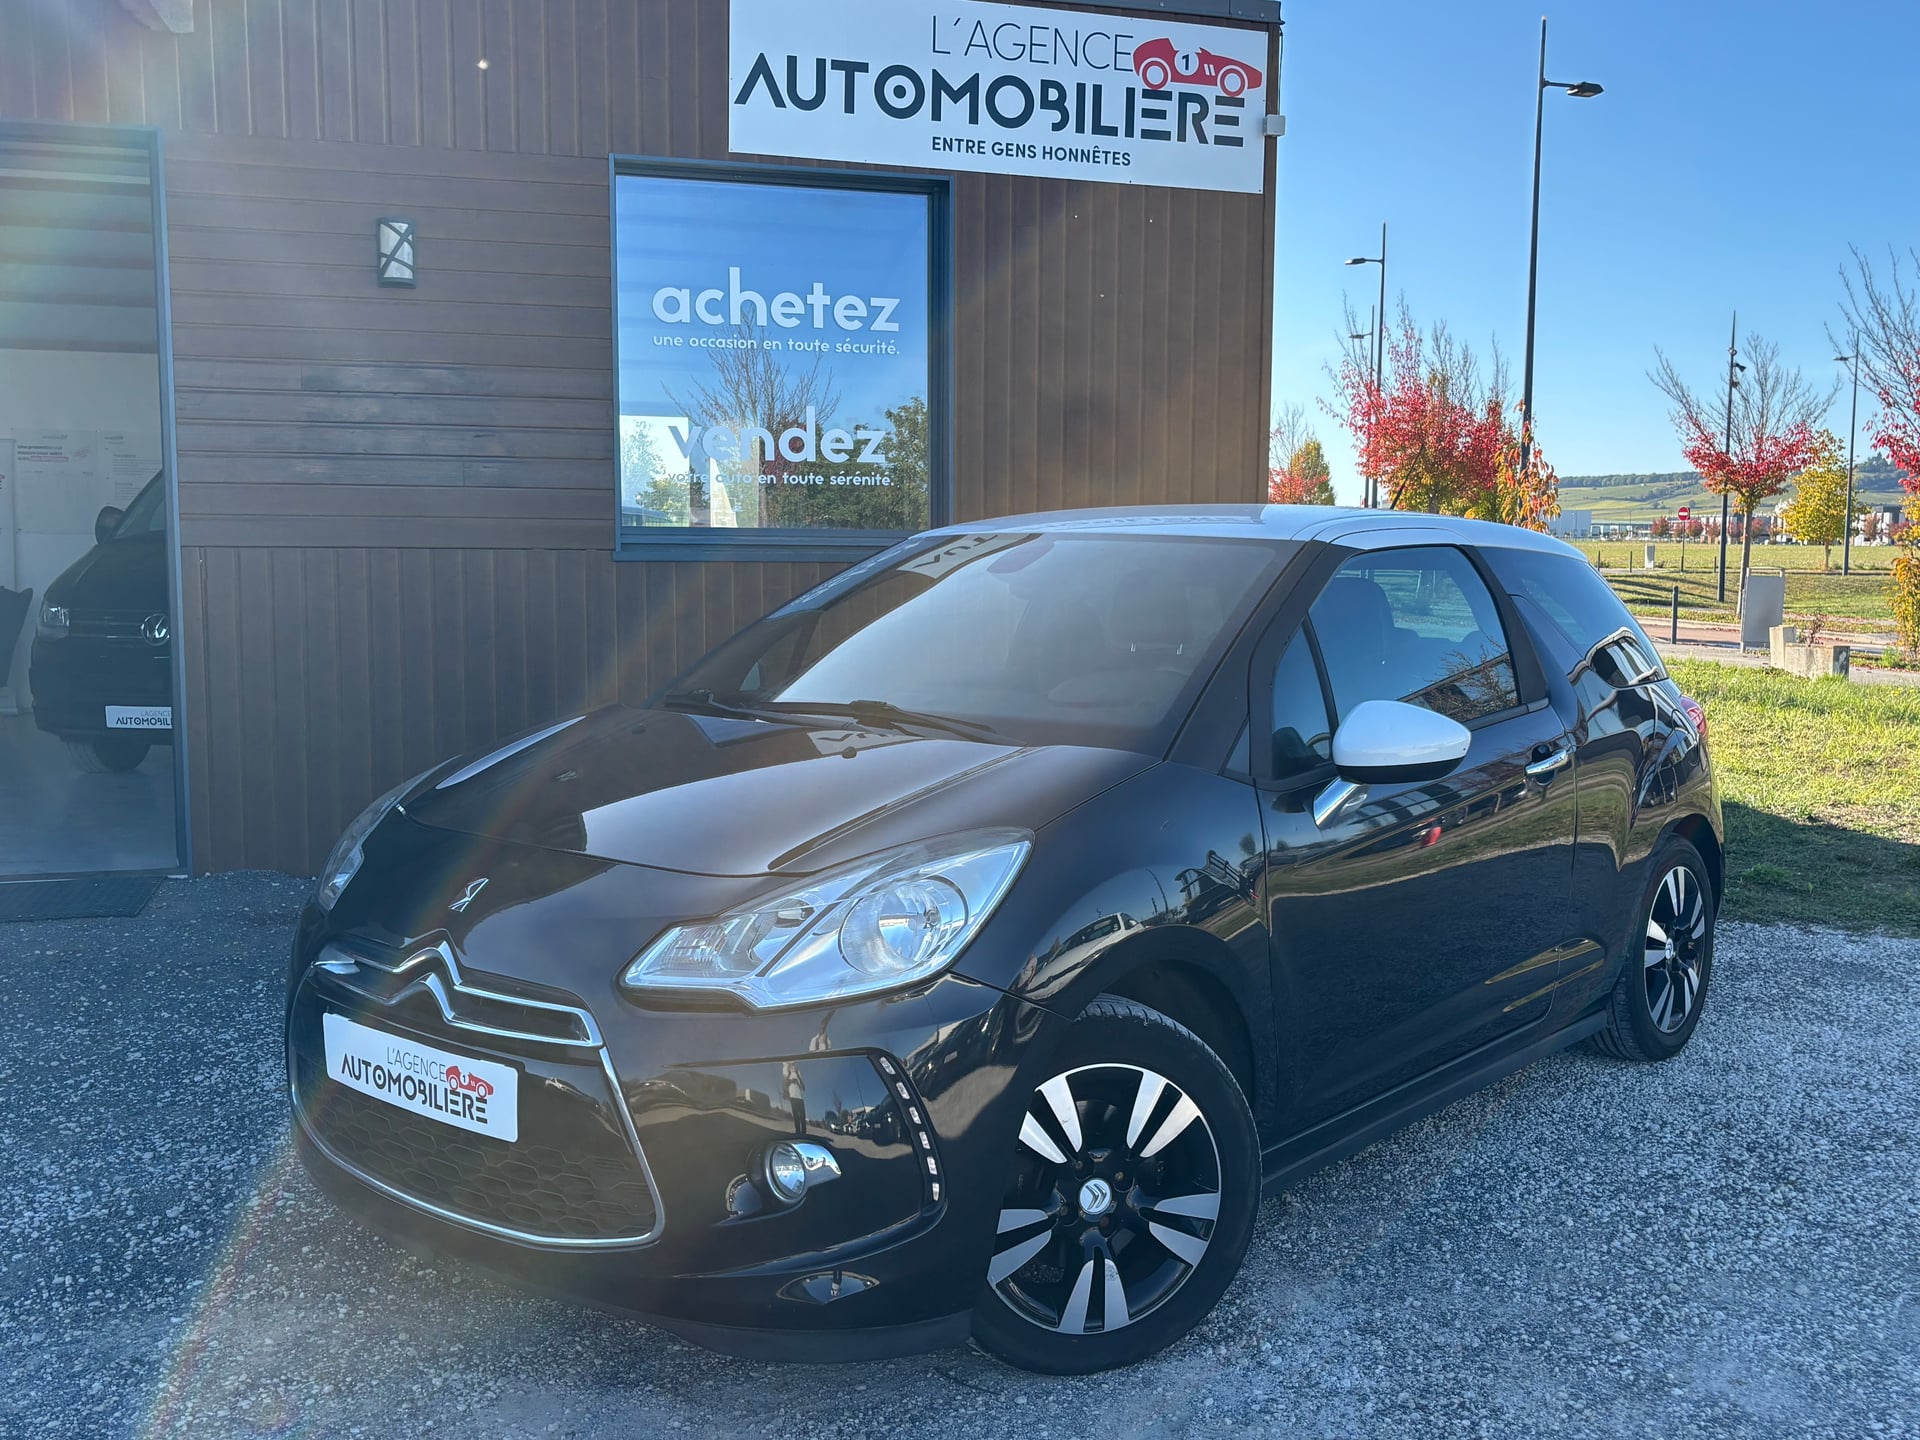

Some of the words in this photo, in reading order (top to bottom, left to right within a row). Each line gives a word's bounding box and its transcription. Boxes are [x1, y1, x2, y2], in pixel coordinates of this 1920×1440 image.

[1181, 53, 1190, 71] 1
[932, 136, 986, 156] ENTRE
[991, 140, 1037, 160] GENS
[1041, 144, 1132, 167] HONNÊTES
[652, 266, 900, 332] achetez
[653, 335, 684, 347] une
[689, 334, 757, 350] occasion
[763, 339, 782, 351] en
[787, 337, 830, 352] toute
[835, 338, 900, 355] sécurité.
[667, 405, 886, 464] vendez
[668, 471, 708, 483] votre
[716, 472, 752, 484] auto
[758, 475, 777, 485] en
[782, 471, 825, 485] toute
[830, 470, 894, 487] sérénité.
[386, 1046, 447, 1083] L'AGENCE
